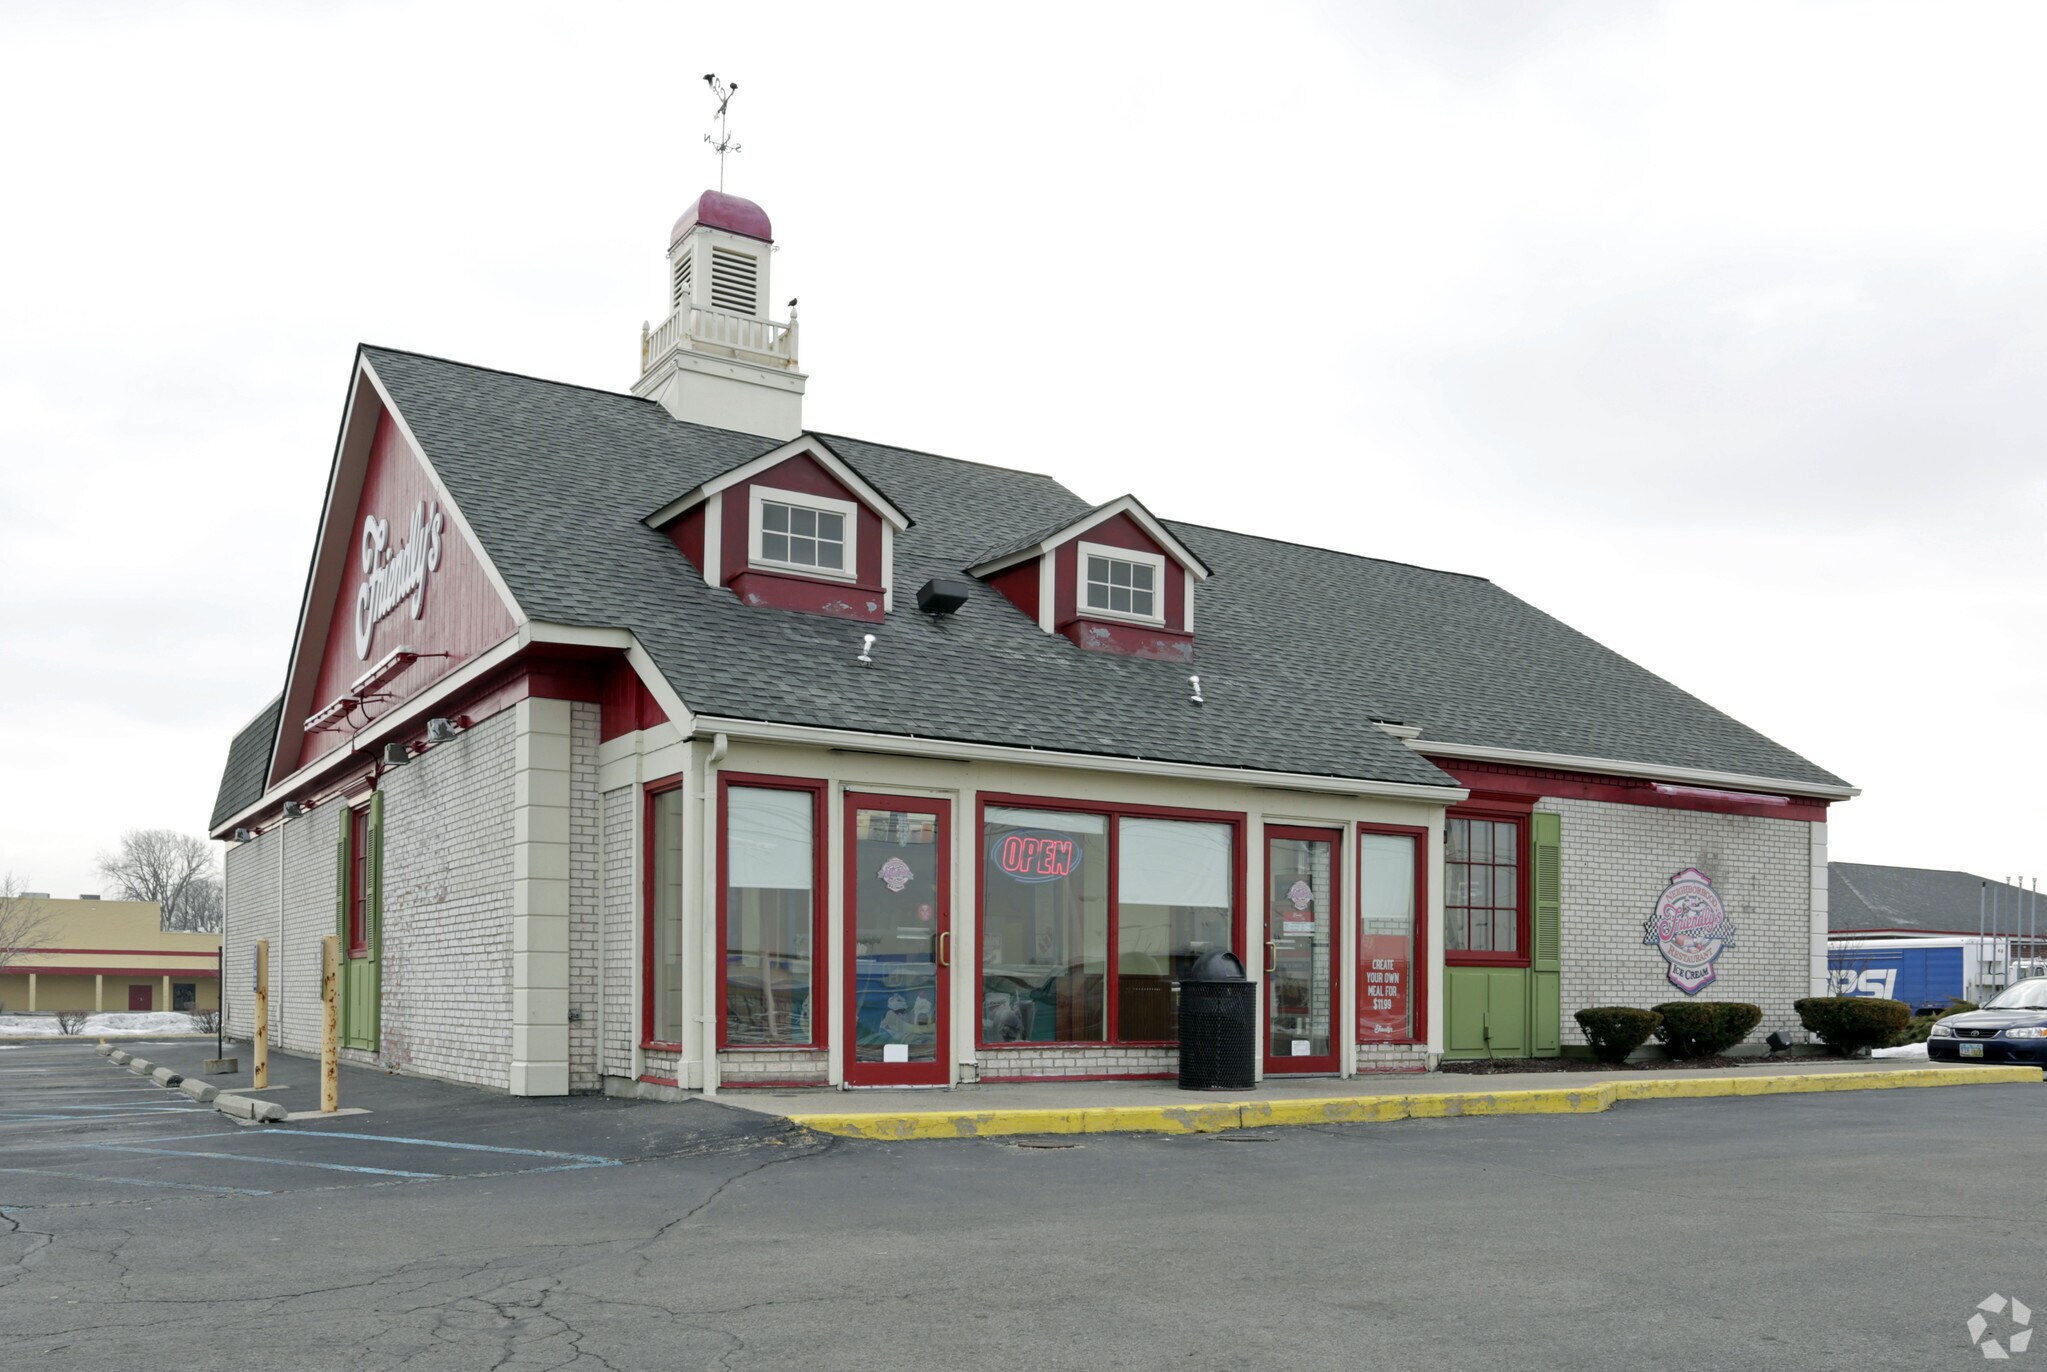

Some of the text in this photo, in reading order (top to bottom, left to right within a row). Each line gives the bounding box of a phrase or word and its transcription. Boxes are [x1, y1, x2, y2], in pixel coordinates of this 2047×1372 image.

[356, 500, 443, 661] Friendly's
[1002, 836, 1073, 876] OPEN
[1658, 903, 1722, 943] Friendly's
[1667, 945, 1713, 963] RESTAURANT
[1372, 959, 1395, 970] CREATE
[1672, 964, 1709, 980] ICE CREAM
[1366, 972, 1400, 983] YOUR OWN
[1368, 985, 1397, 996] MEAL FOR
